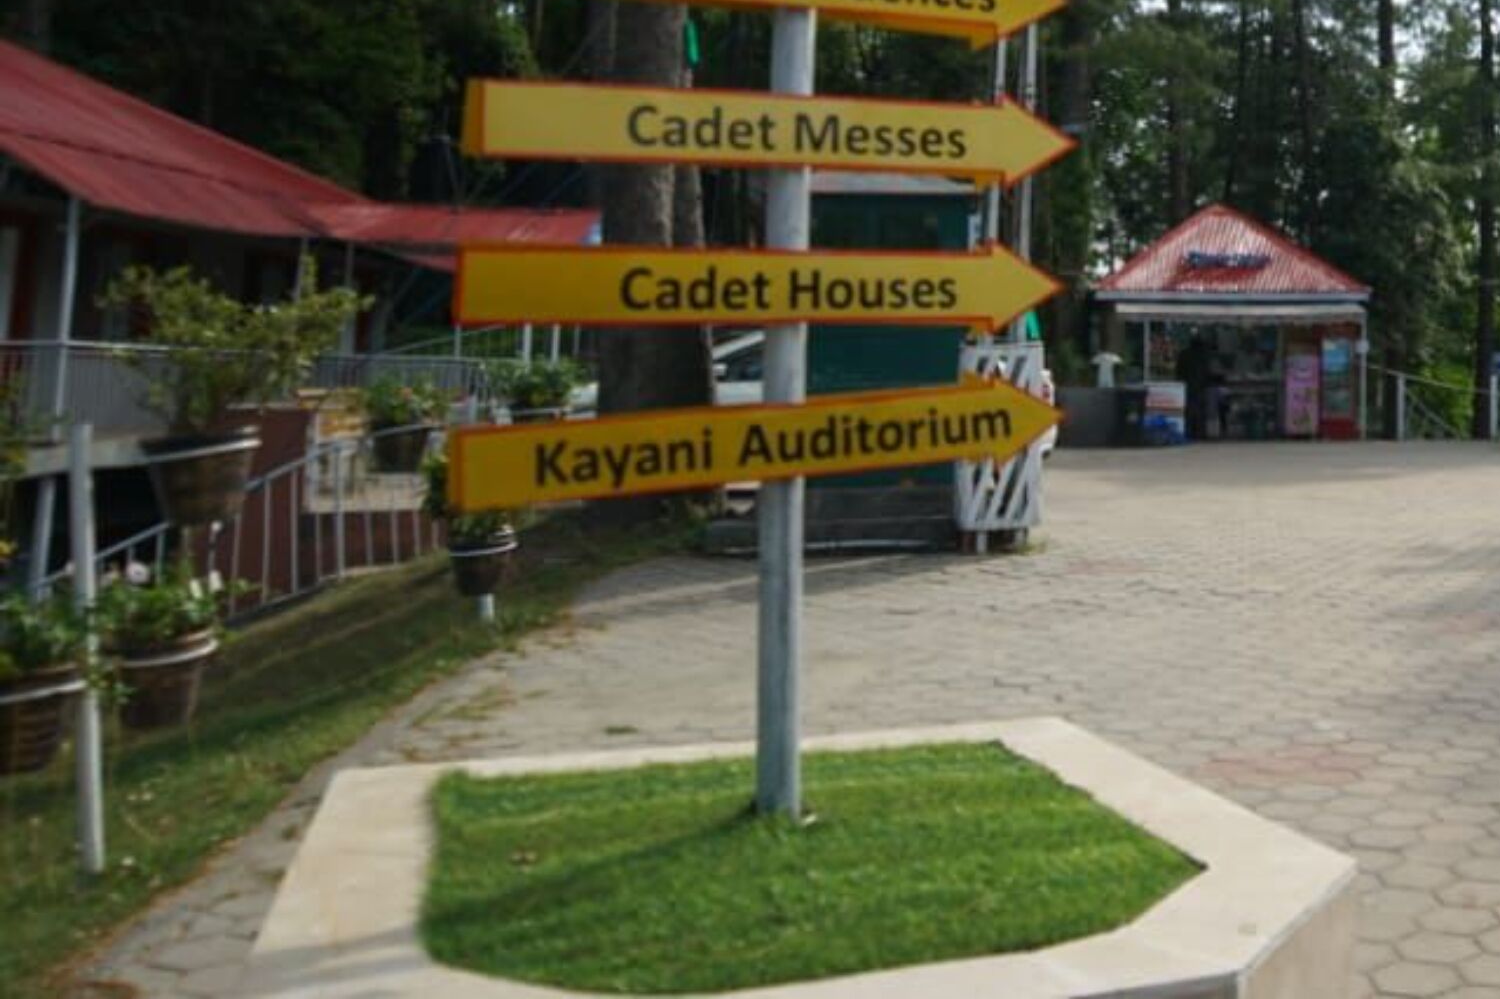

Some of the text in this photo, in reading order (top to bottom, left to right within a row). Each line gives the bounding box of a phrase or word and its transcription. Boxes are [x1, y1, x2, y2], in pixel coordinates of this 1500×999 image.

[626, 104, 969, 160] Cadet Messes
[618, 265, 959, 313] Cadet Houses
[534, 405, 1014, 489] Kayani Auditorium
